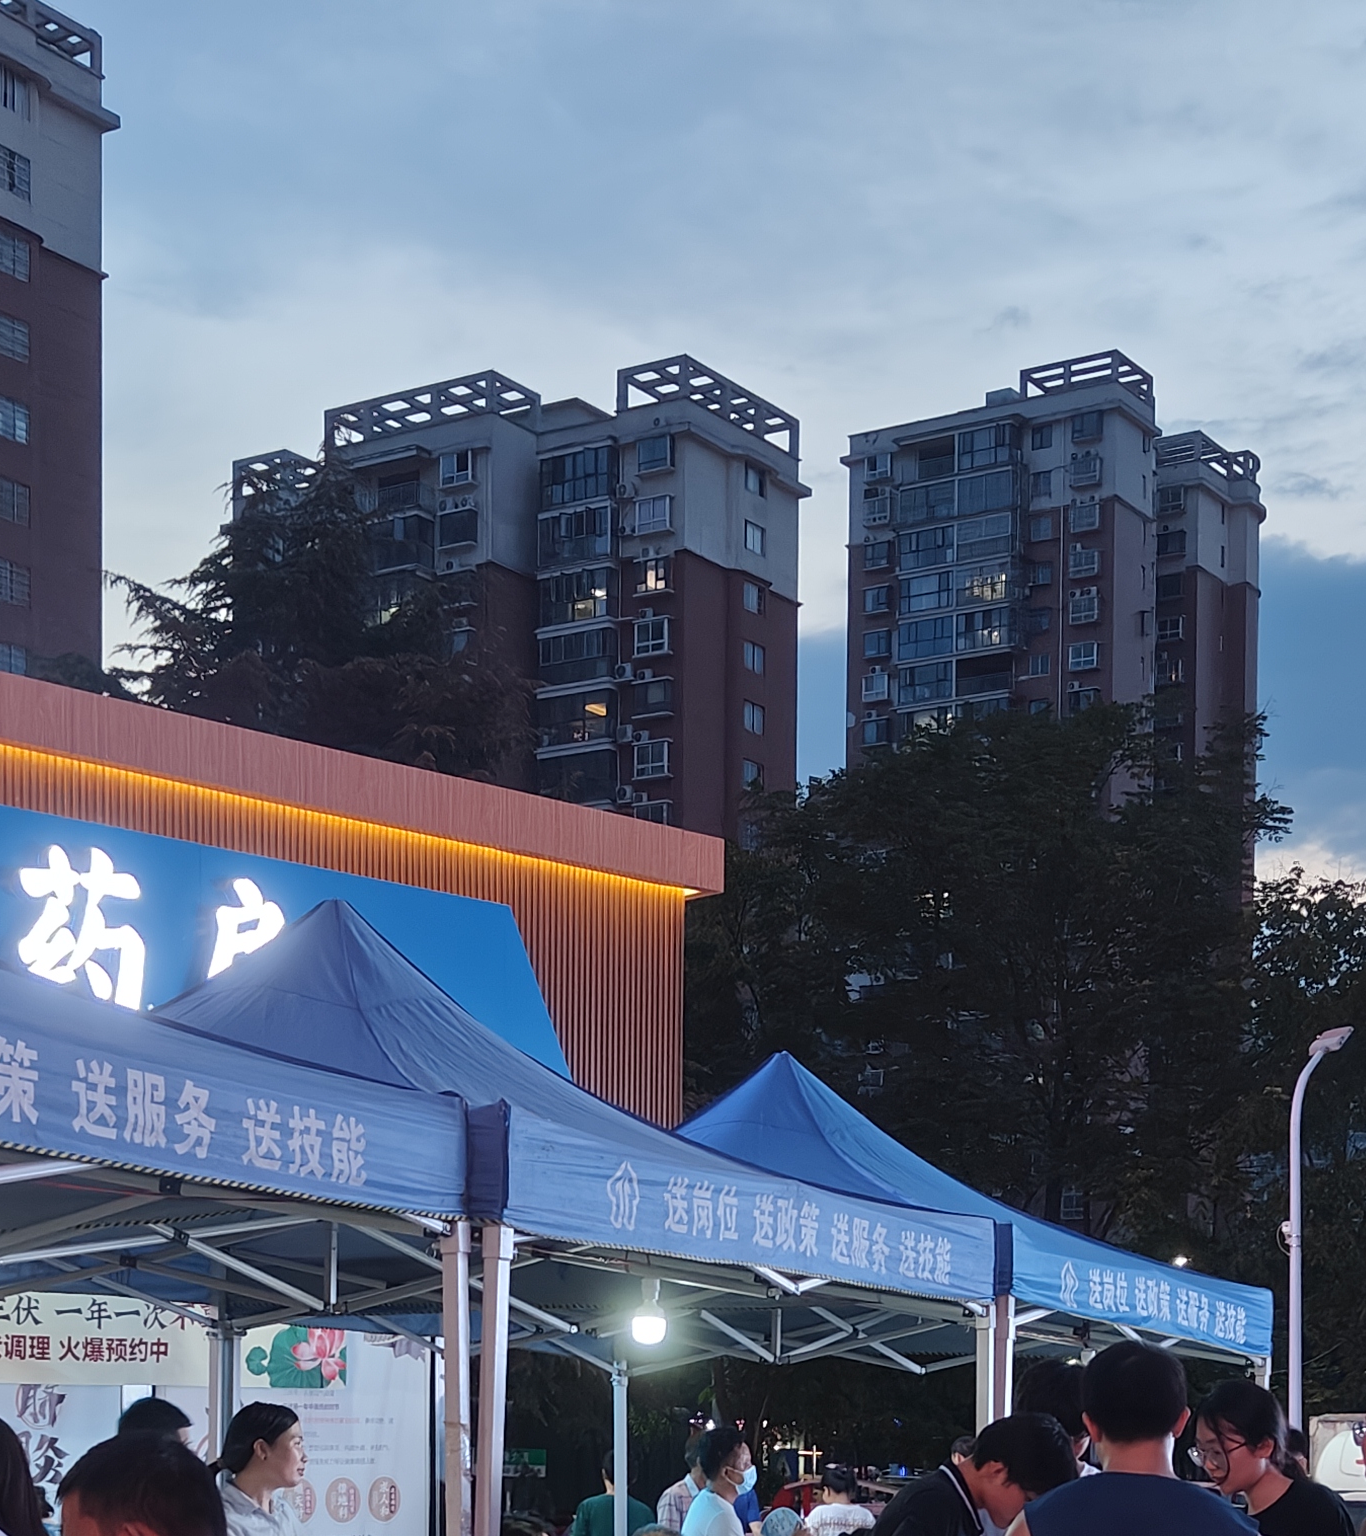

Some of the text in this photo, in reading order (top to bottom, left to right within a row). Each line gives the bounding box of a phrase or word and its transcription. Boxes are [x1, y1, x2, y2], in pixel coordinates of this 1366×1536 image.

[71, 1058, 216, 1159] 送服务
[241, 1097, 368, 1186] 送技能
[664, 1174, 953, 1286] 送岗位 送政策 送服务 送技能
[59, 1336, 170, 1364] 火爆预约中
[1088, 1268, 1248, 1345] 送岗位 送政策 送服务 送技能
